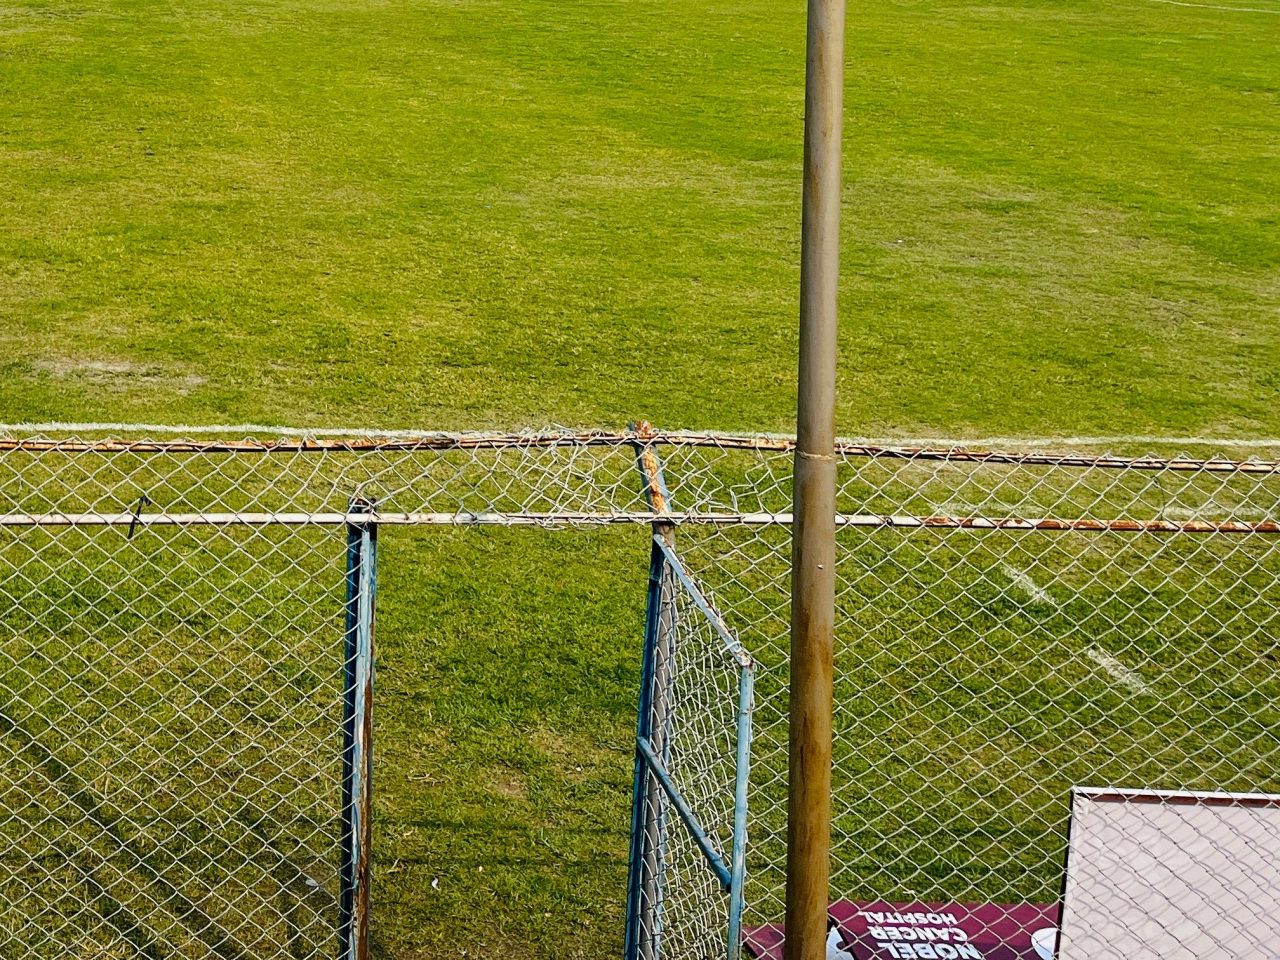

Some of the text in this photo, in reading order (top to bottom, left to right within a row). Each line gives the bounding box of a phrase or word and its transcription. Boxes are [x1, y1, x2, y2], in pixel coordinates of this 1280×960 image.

[858, 911, 959, 926] HOSPITAL
[867, 926, 969, 942] CANCER
[877, 942, 982, 960] NOBEL
